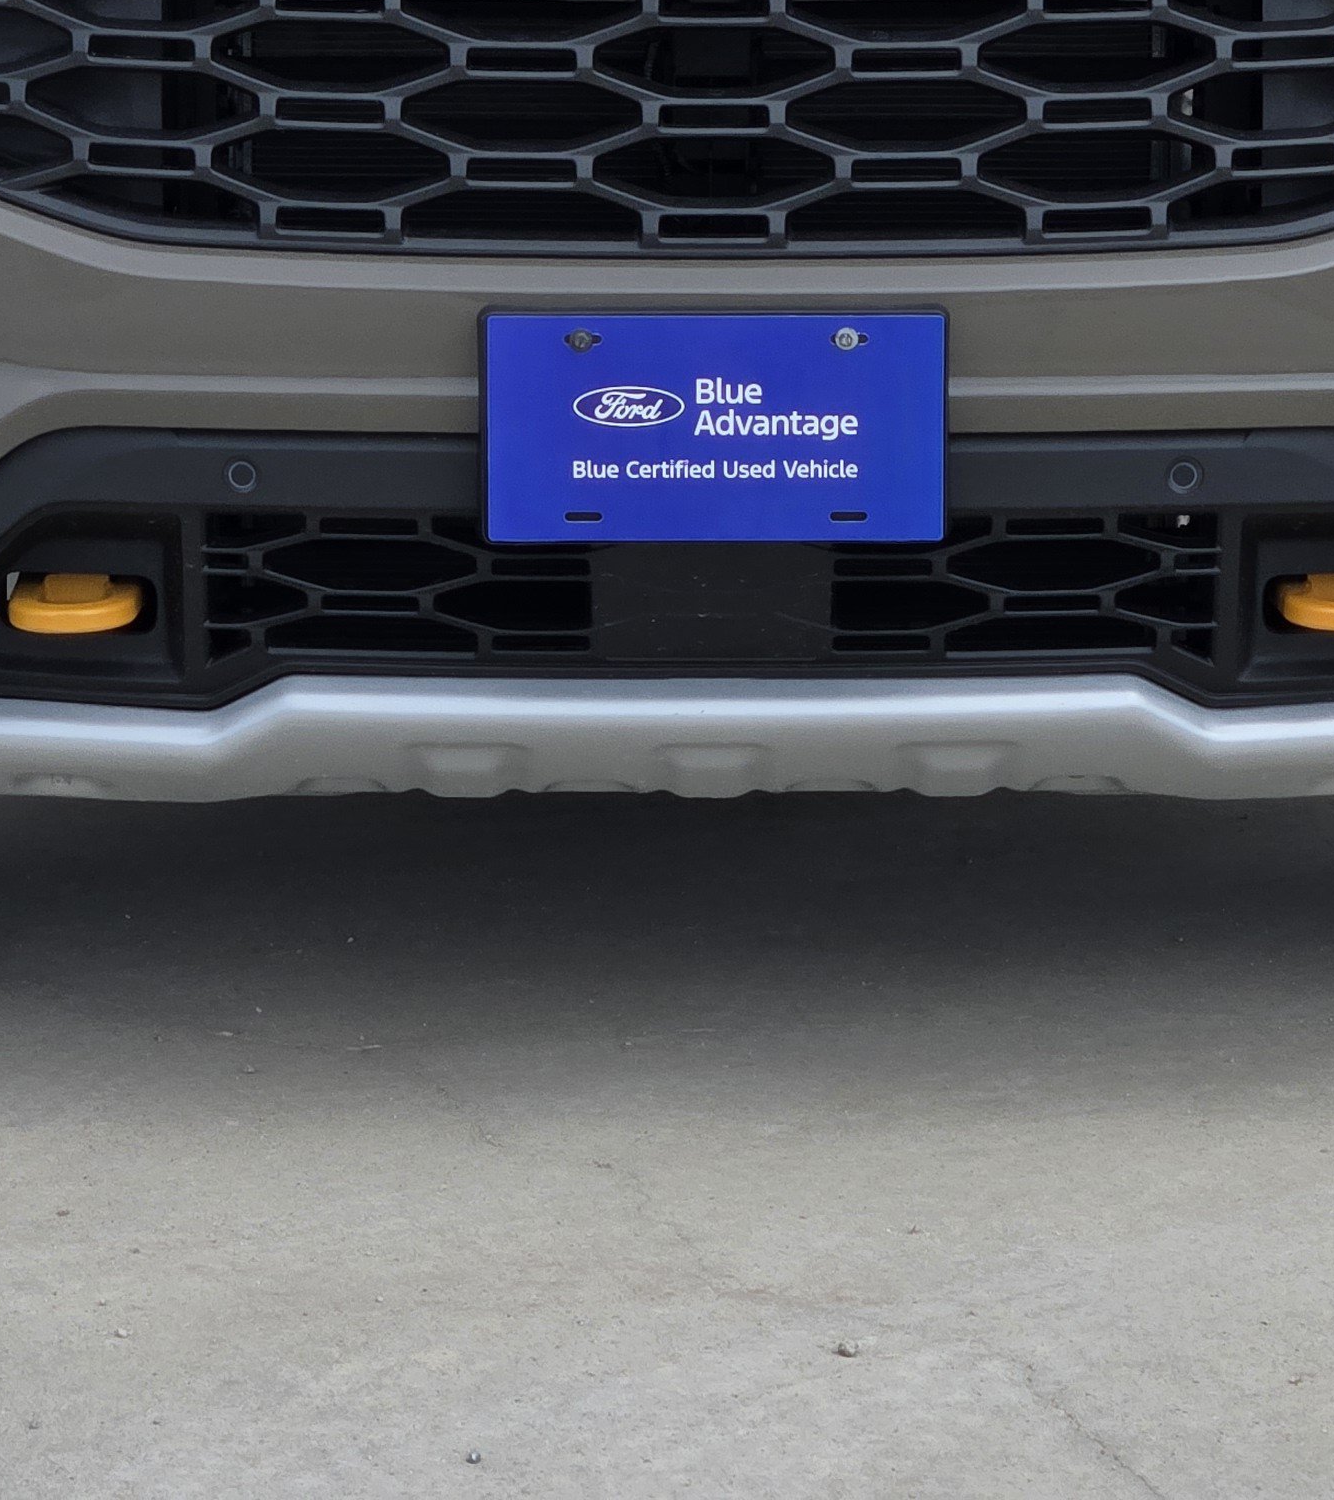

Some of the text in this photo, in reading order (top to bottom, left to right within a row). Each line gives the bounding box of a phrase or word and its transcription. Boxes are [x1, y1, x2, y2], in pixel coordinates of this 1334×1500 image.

[694, 377, 762, 405] Blue
[594, 391, 663, 421] Ford
[694, 409, 859, 441] Advantage
[572, 459, 859, 480] Blue Certified Used Vehicle
